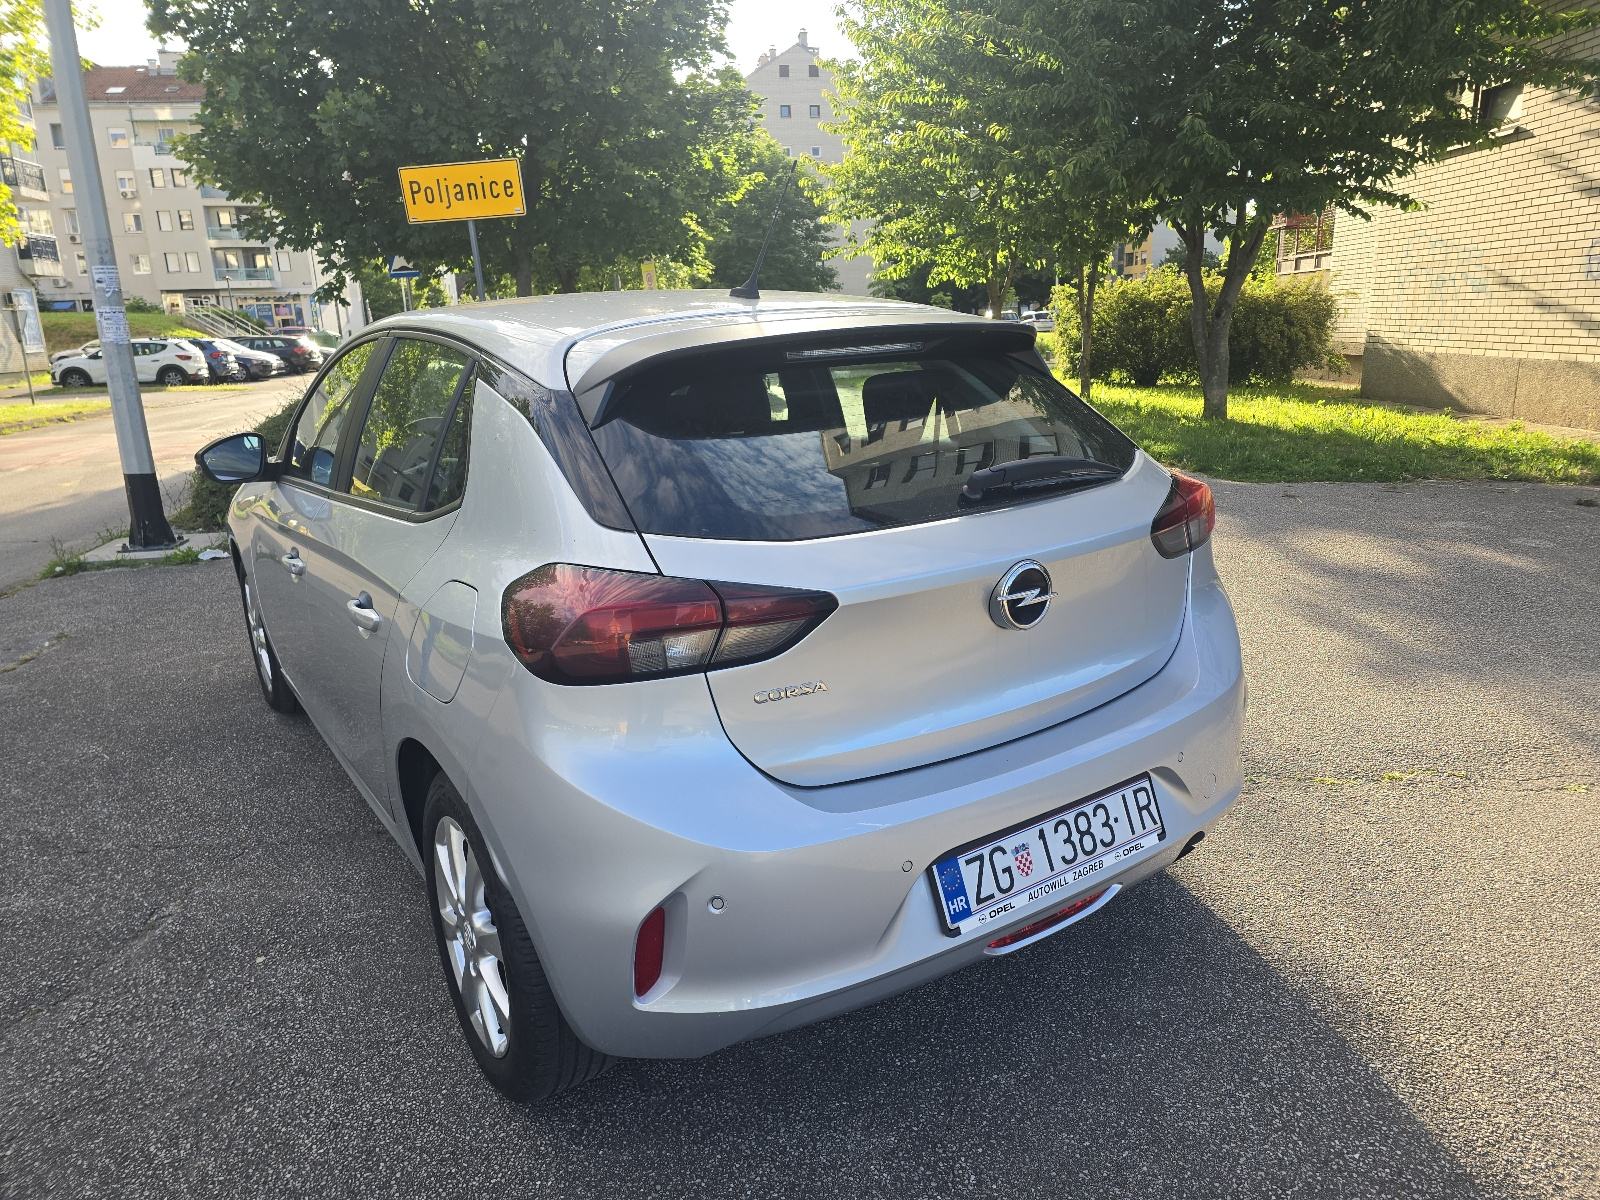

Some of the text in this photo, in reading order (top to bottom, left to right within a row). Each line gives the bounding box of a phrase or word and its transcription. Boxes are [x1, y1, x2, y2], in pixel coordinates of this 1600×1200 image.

[409, 176, 513, 209] Poljanice
[753, 680, 828, 704] CORSA
[964, 845, 1015, 906] ZG
[989, 843, 1145, 919] OPEL AUTOWILL ZAGREB OPEL
[949, 895, 968, 916] HR
